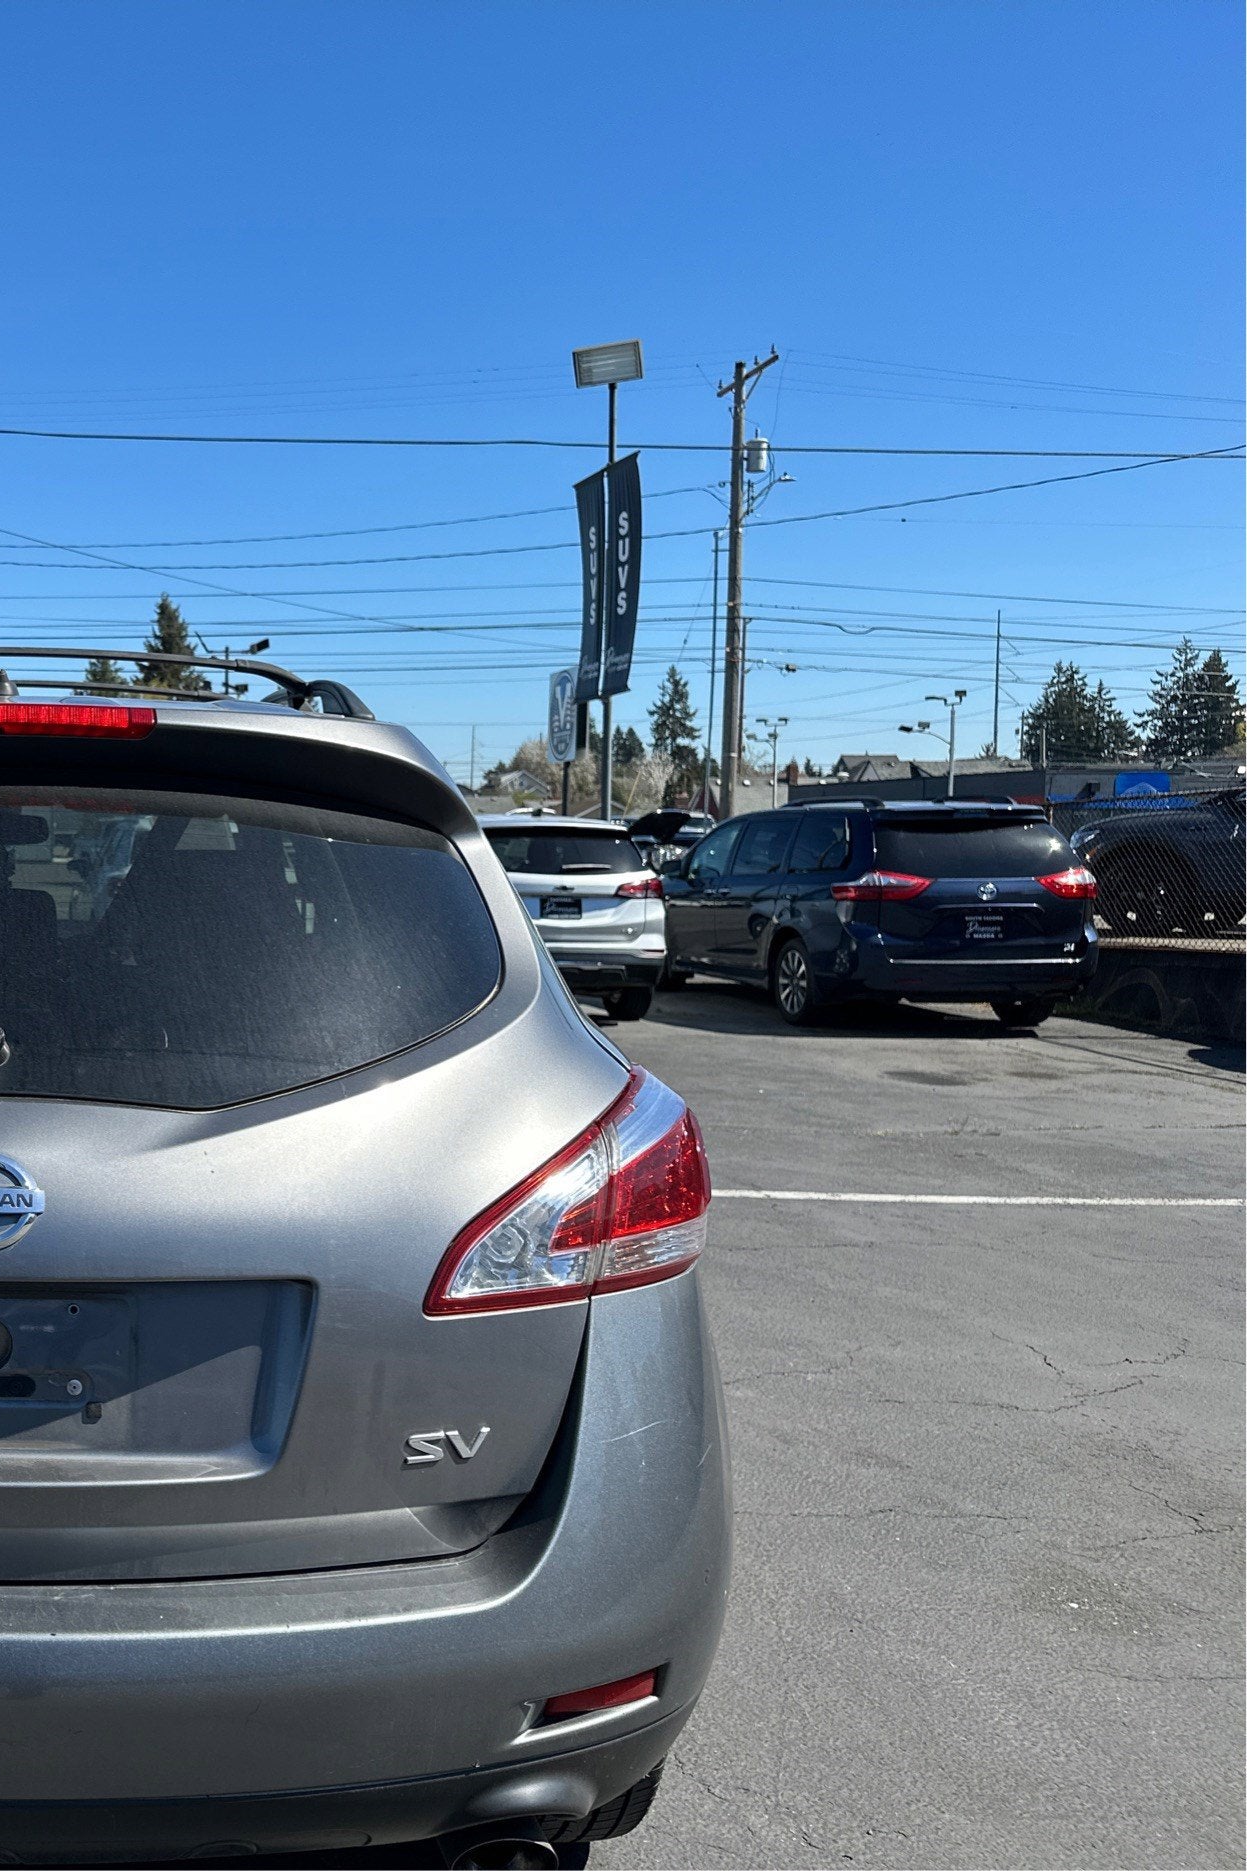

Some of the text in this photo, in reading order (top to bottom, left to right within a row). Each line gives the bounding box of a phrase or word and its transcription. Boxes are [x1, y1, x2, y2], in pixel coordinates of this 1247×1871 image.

[589, 526, 598, 626] SUVS
[617, 510, 630, 616] SUVS
[404, 1426, 491, 1465] SV
